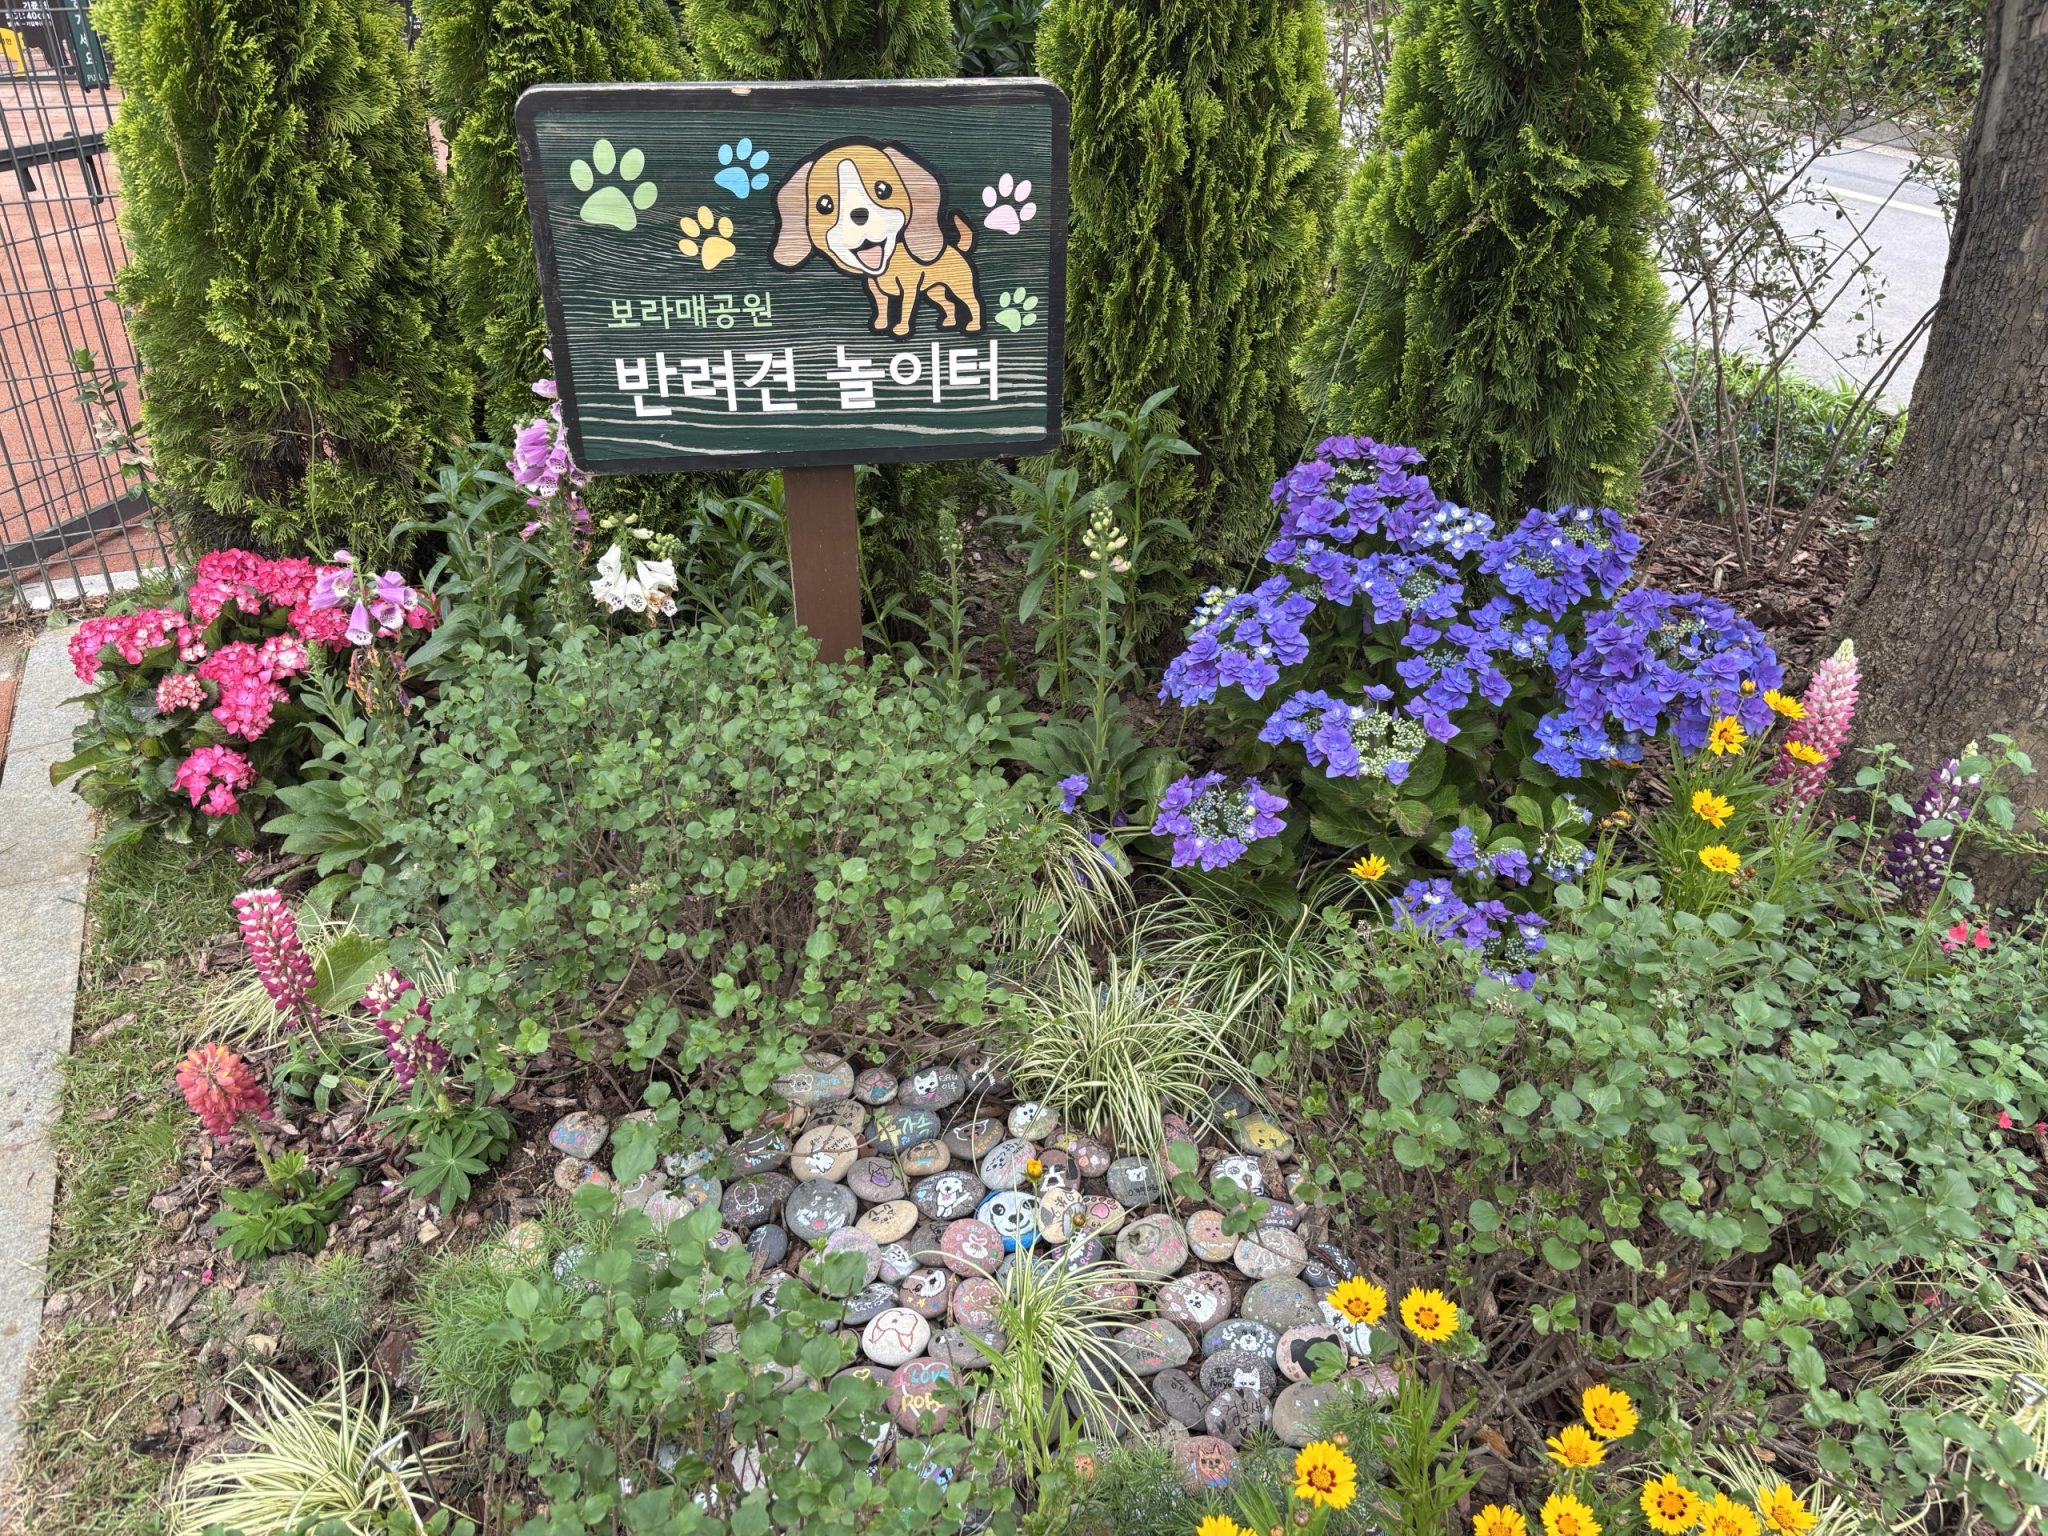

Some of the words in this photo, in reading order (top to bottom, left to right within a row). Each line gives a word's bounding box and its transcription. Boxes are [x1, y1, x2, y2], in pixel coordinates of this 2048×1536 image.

[86, 73, 104, 82] PUL
[608, 291, 773, 330] 보라매공원
[615, 350, 799, 417] 반려견
[826, 340, 999, 410] 놀이터
[911, 1368, 951, 1384] LOVE
